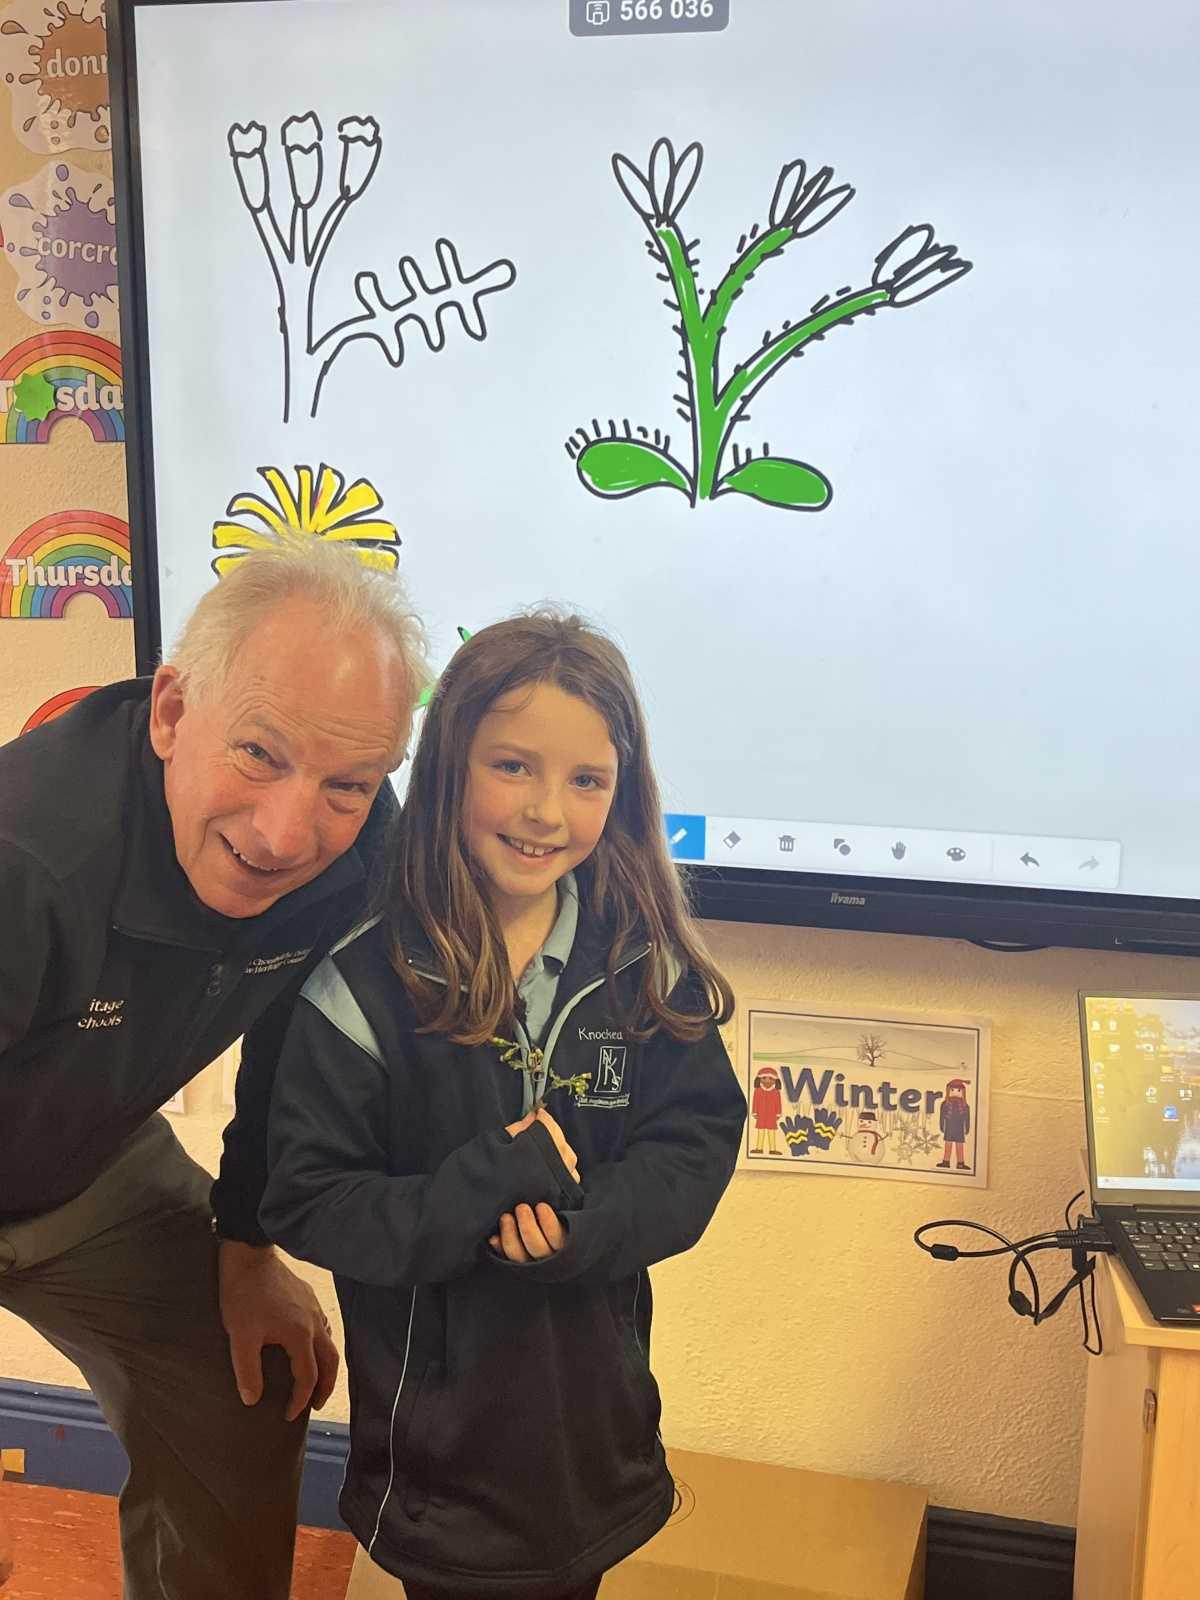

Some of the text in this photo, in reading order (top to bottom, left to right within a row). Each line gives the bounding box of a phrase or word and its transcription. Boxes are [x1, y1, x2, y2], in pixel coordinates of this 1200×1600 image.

[620, 0, 713, 20] 566 036
[578, 1026, 623, 1041] Knockea
[780, 1065, 943, 1114] Winter
